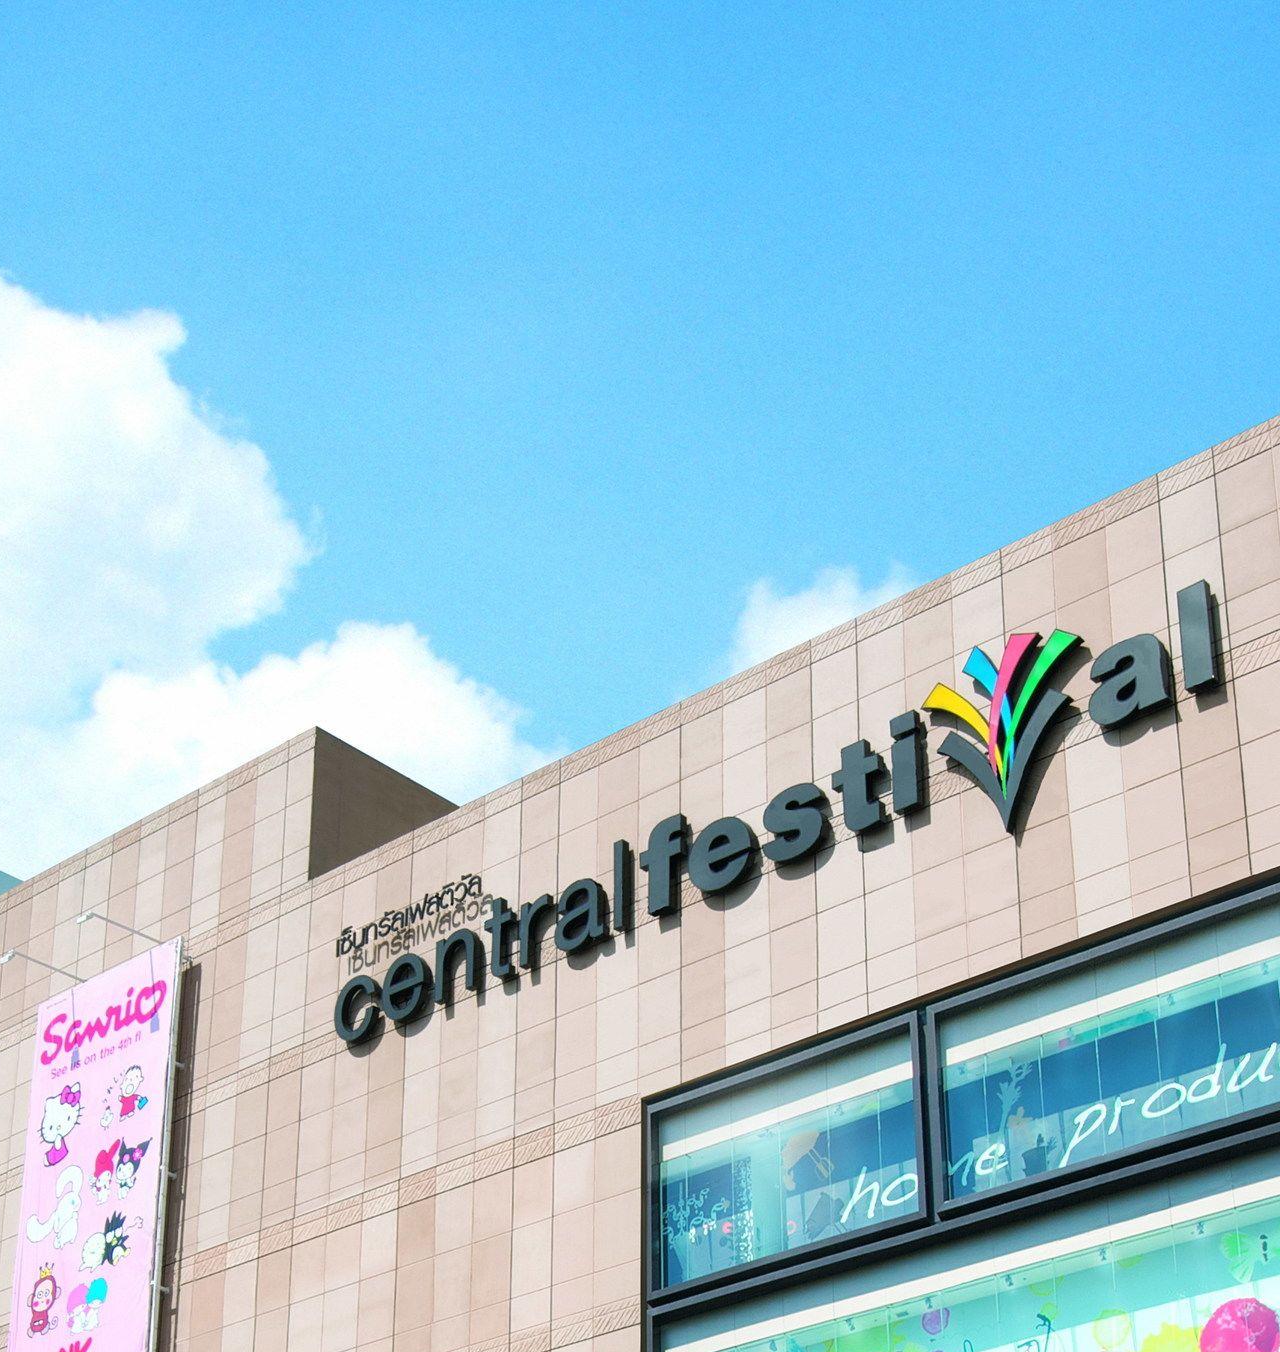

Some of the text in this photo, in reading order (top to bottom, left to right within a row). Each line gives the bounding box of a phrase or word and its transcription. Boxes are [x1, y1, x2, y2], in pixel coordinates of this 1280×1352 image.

[332, 580, 1219, 1046] centralfestival
[336, 873, 483, 958] เซ็นทรัลเฟสติวัล
[40, 980, 167, 1065] Sanrio
[51, 1066, 68, 1080] See
[70, 1059, 81, 1071] us
[84, 1053, 97, 1065] on
[100, 1046, 115, 1060] the
